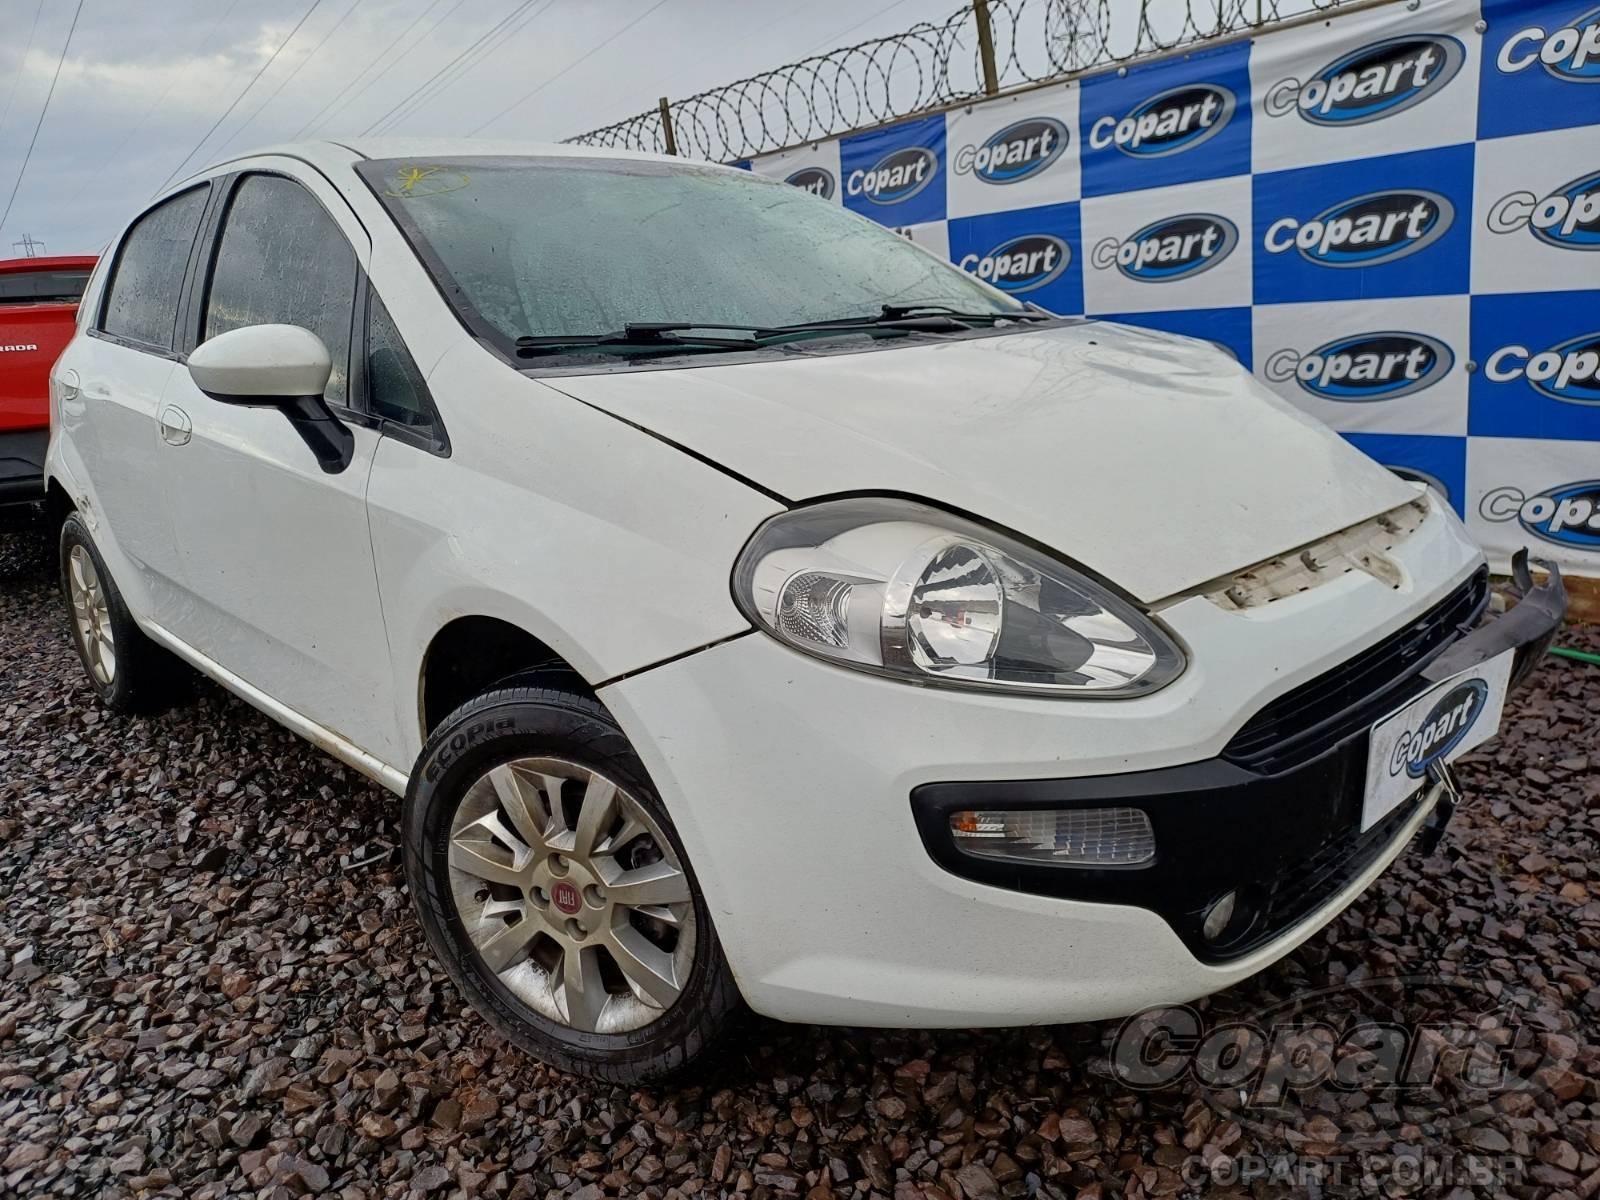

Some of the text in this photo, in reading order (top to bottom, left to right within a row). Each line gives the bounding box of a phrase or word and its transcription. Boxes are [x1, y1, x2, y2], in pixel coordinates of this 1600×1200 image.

[1263, 46, 1435, 117] Copart
[1089, 93, 1217, 150] Copart
[953, 127, 1053, 176] Copart
[847, 155, 927, 196] Copart
[1091, 225, 1218, 271] Copart
[1263, 201, 1429, 255] Copart
[959, 244, 1057, 283] Copart
[1264, 343, 1426, 388] Copart
[1484, 344, 1600, 389] Cop
[1390, 691, 1475, 777] Copart
[559, 889, 576, 906] FIAT
